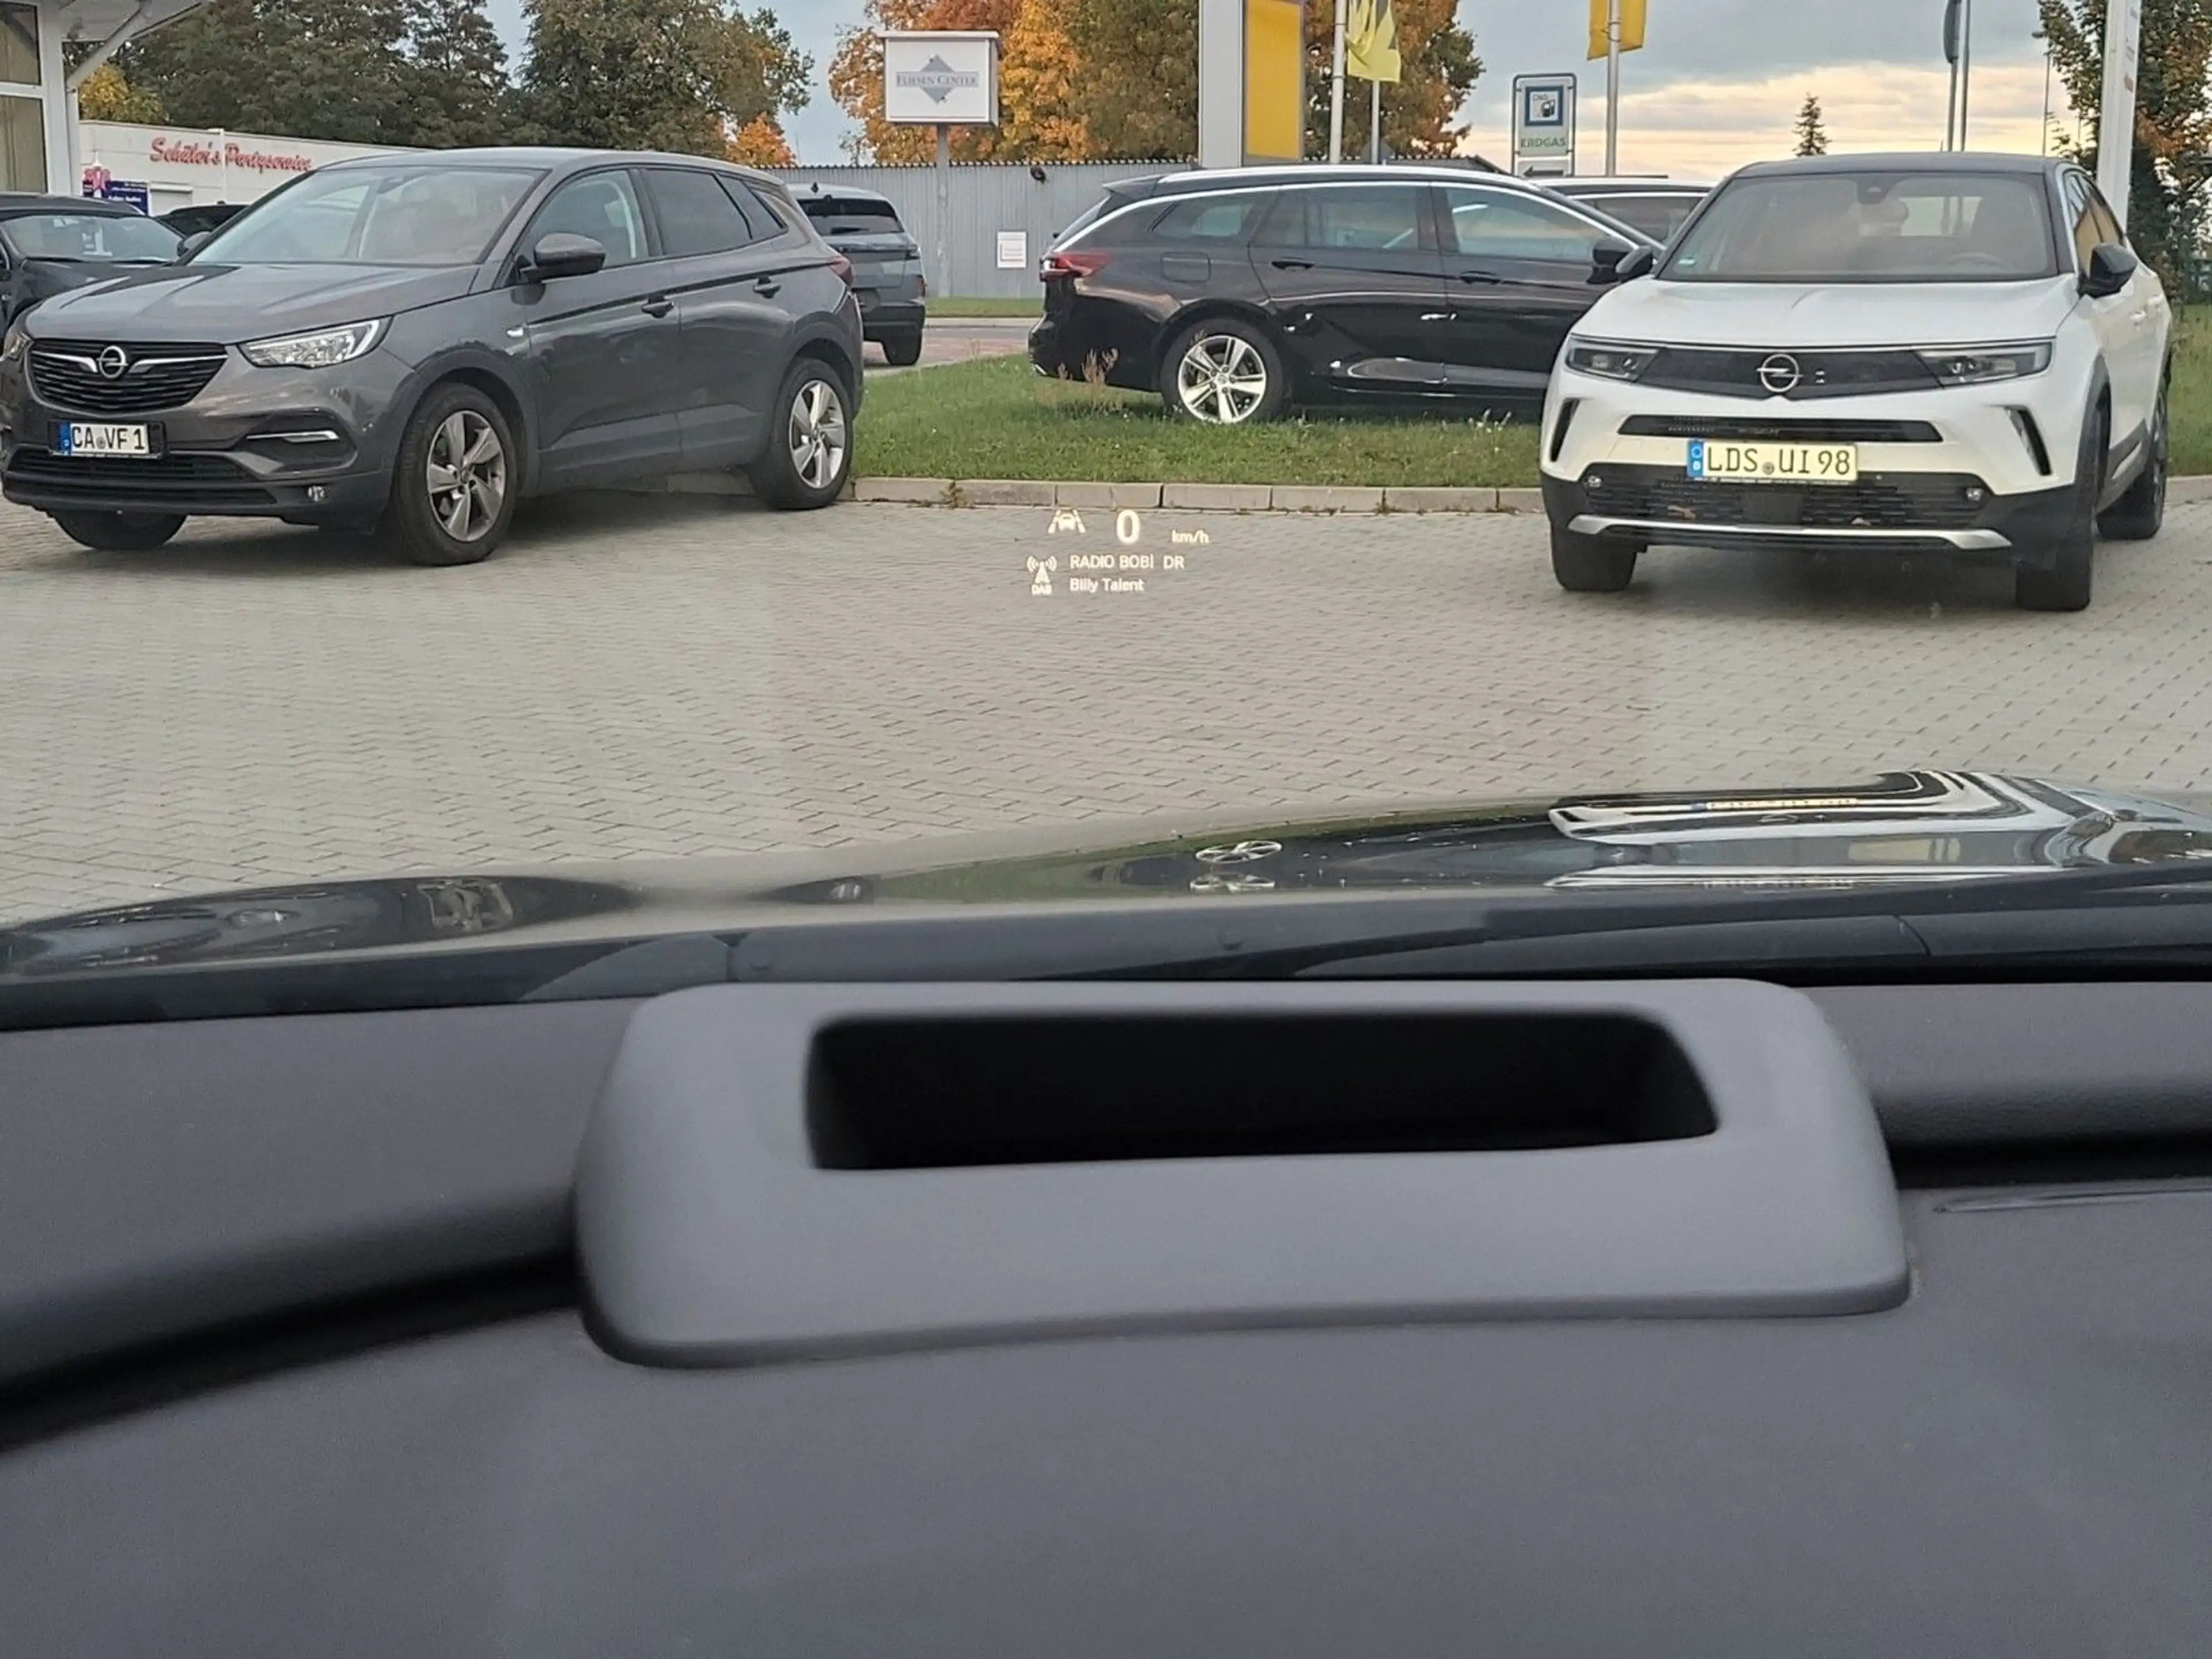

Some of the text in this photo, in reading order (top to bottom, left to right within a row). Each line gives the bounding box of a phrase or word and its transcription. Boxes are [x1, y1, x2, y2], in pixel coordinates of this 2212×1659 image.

[1521, 137, 1566, 147] ERDGAS
[71, 426, 145, 450] CA VF 1
[1707, 446, 1850, 475] LDS UI 98
[1116, 510, 1210, 544] 0 km/h
[1070, 554, 1115, 569] RADIO
[1164, 555, 1185, 570] DR
[1032, 584, 1052, 596] DAB
[1070, 577, 1145, 593] Billy Talent
